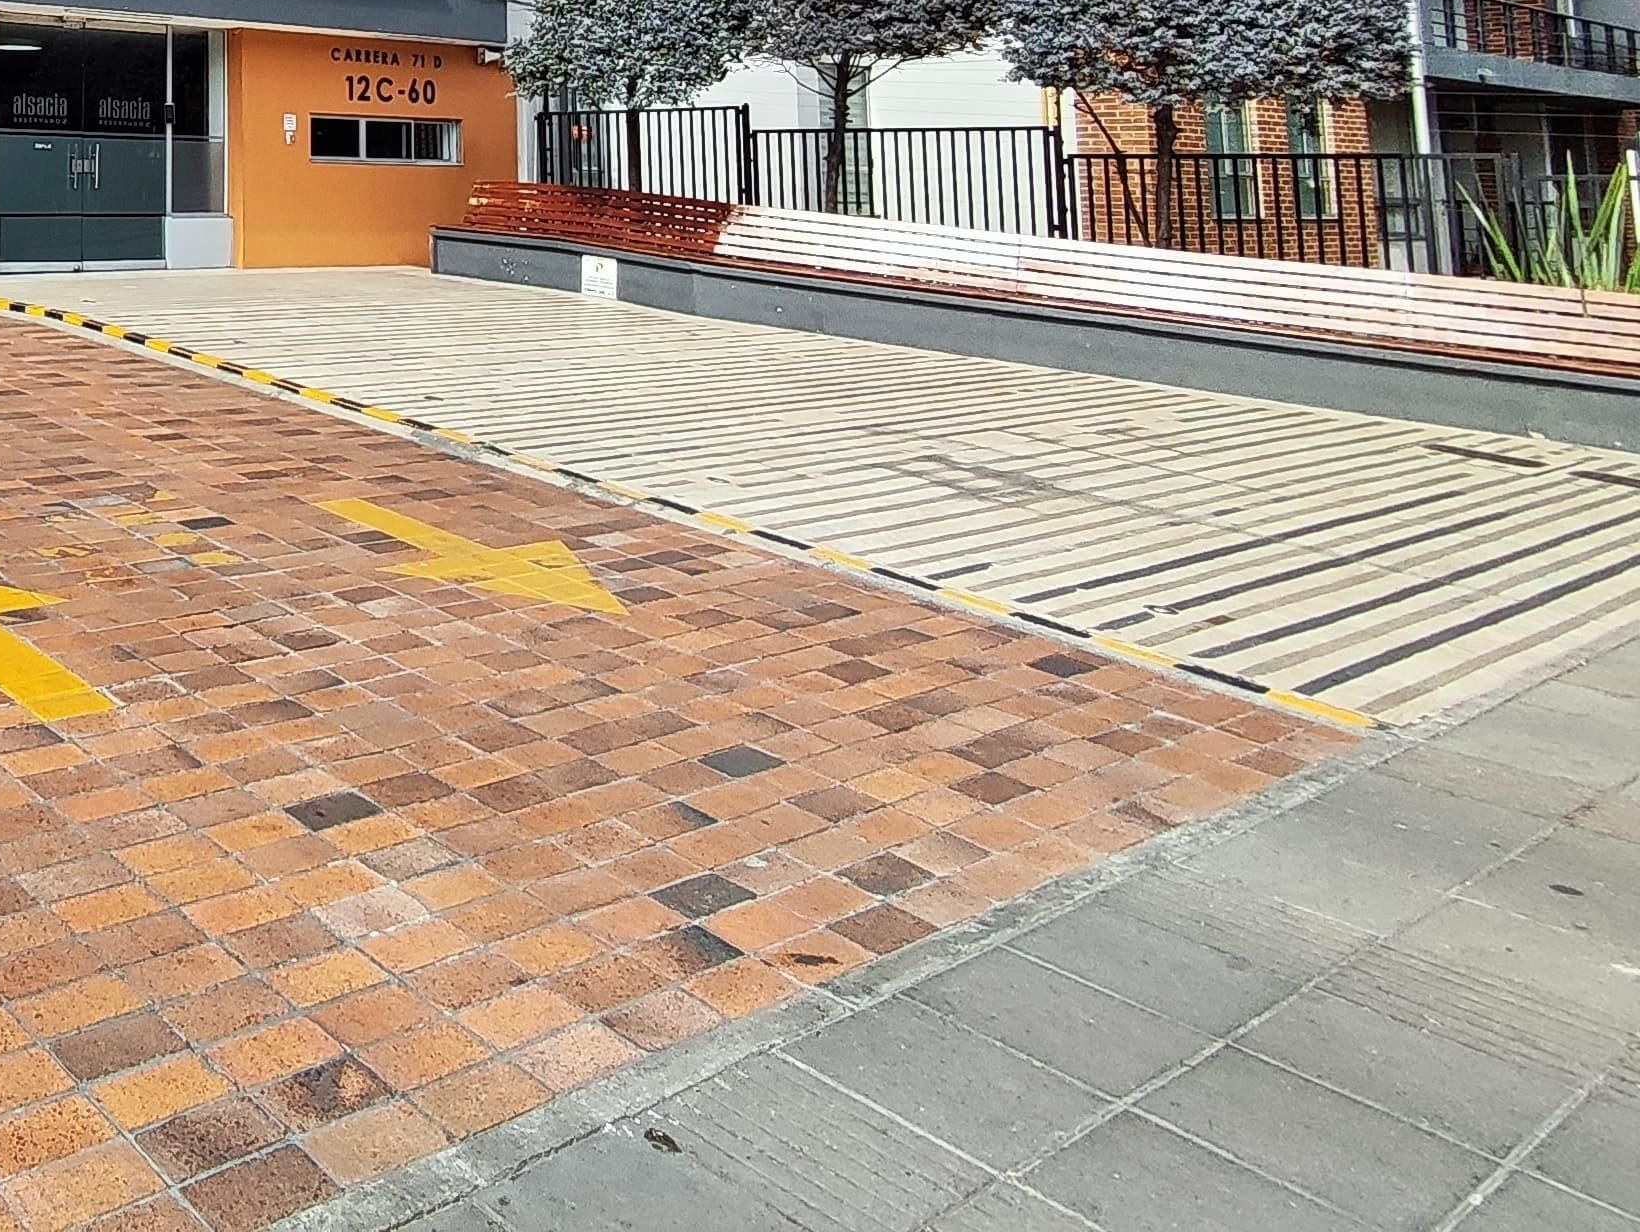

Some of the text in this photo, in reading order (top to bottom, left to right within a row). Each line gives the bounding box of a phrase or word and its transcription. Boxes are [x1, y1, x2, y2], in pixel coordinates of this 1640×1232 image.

[330, 47, 443, 69] CARRERA 71 D
[345, 75, 436, 105] 12C-60
[13, 92, 68, 116] alsacia
[99, 97, 151, 119] alsacia
